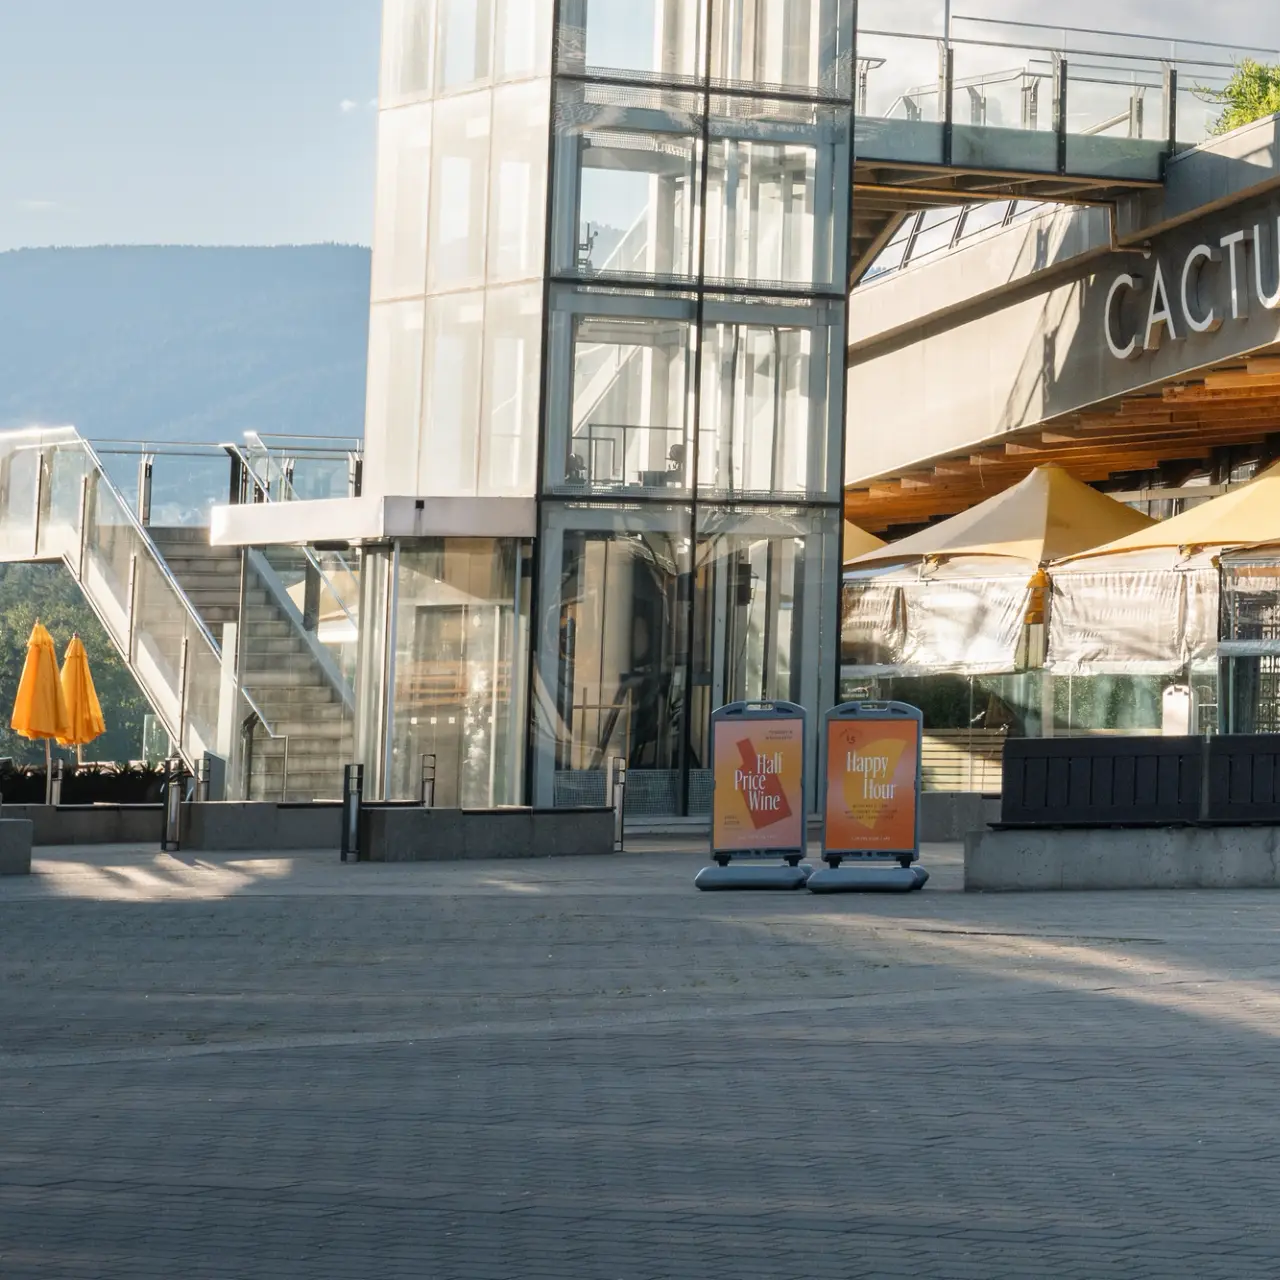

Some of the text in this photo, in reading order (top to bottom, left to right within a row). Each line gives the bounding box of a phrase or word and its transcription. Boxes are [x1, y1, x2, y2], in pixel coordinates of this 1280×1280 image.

[756, 750, 784, 774] Half
[846, 749, 889, 779] Happy
[734, 768, 767, 792] Price
[862, 777, 897, 800] Hour
[748, 789, 781, 812] Wine
